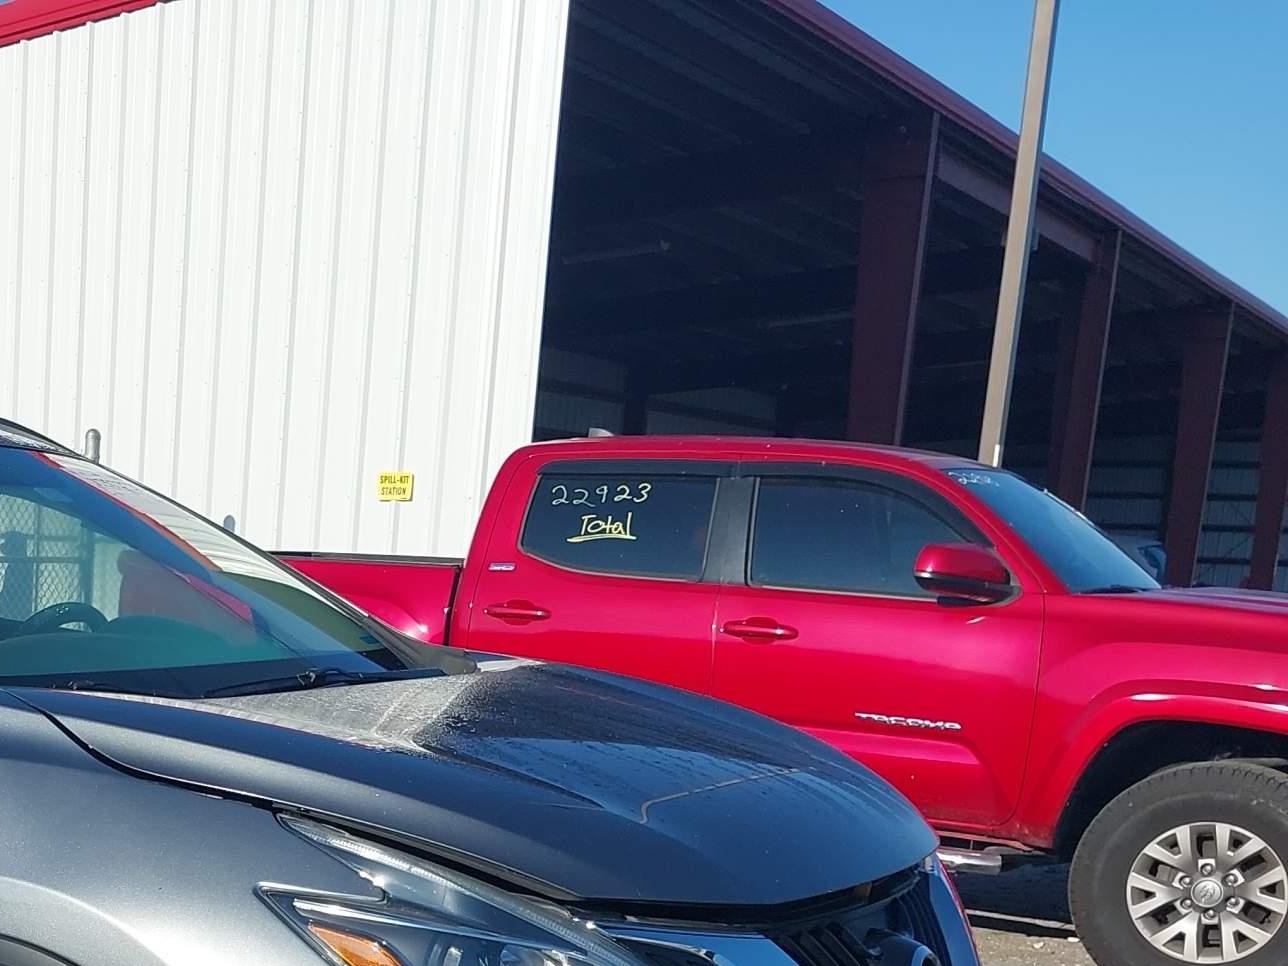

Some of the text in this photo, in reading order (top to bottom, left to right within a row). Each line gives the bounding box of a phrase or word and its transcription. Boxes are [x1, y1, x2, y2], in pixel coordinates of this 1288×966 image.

[380, 475, 410, 484] SPILL-KIT
[381, 487, 407, 496] STATION
[552, 483, 652, 508] 22923
[580, 512, 633, 537] Total
[854, 712, 962, 730] TACOMA
